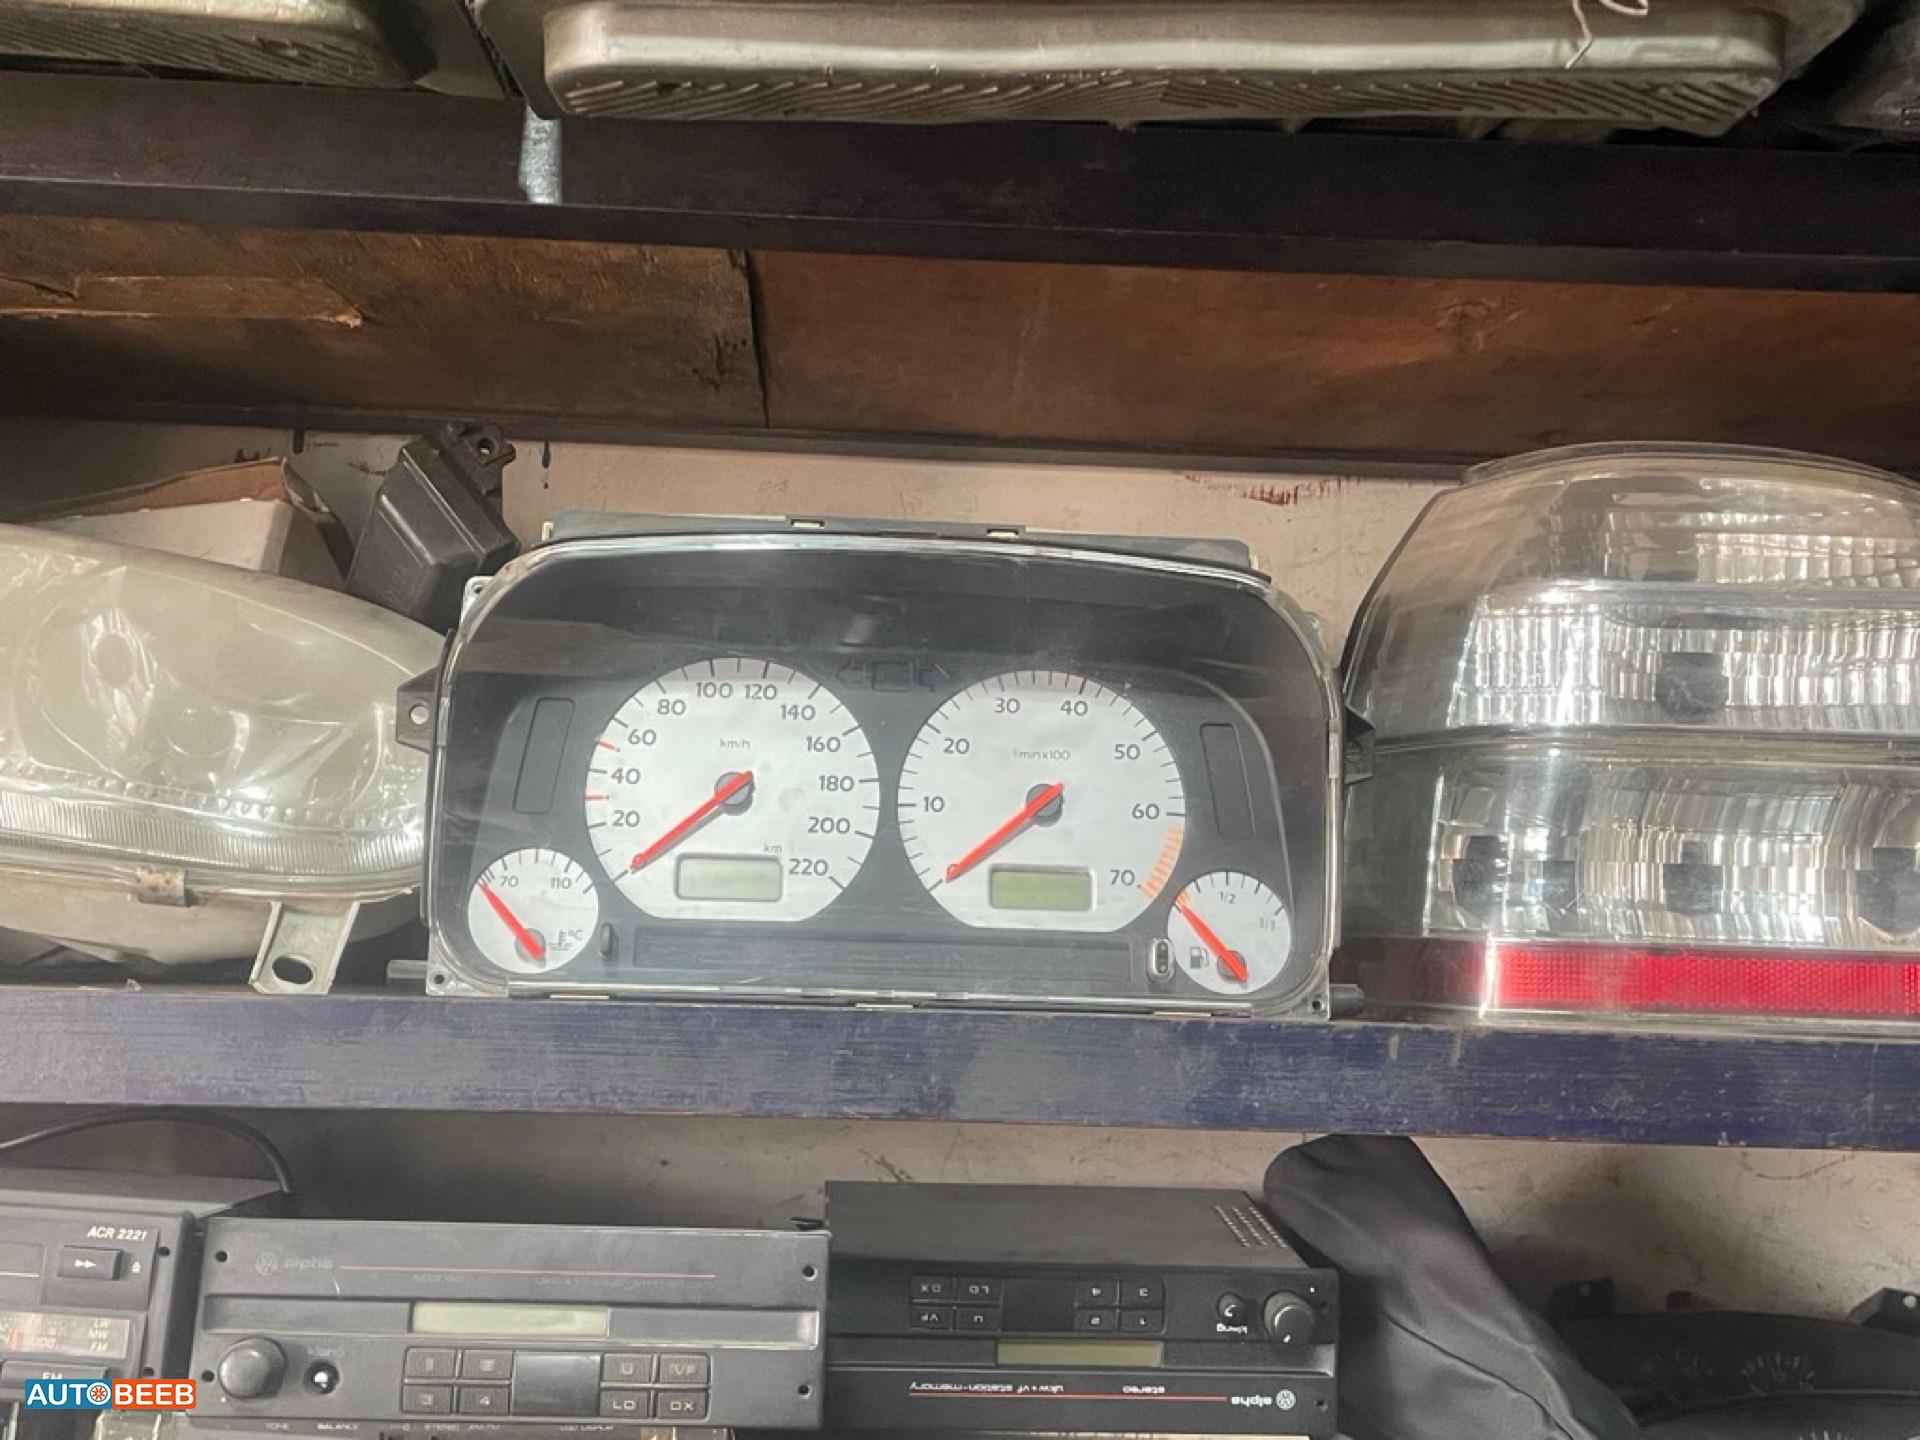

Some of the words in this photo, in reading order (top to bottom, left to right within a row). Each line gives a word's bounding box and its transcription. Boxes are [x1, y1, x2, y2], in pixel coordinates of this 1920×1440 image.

[696, 682, 733, 699] 100
[744, 684, 778, 701] 120
[657, 699, 686, 715] 80
[781, 704, 816, 721] 140
[994, 697, 1020, 713] 30
[1060, 700, 1088, 717] 40
[628, 729, 657, 746] 60
[806, 736, 841, 753] 160
[943, 738, 970, 755] 20
[1114, 744, 1141, 760] 50
[610, 768, 641, 785] 40
[819, 775, 854, 792] 180
[923, 796, 945, 812] 10
[1131, 803, 1160, 820] 60
[612, 811, 640, 828] 20
[807, 817, 851, 835] 200
[788, 859, 829, 876] 220
[500, 876, 519, 888] 70
[551, 877, 572, 889] 110
[1109, 869, 1135, 886] 70
[86, 1225, 115, 1240] ACR
[116, 1227, 148, 1241] 2221
[670, 1401, 694, 1411] DX
[1230, 1394, 1273, 1407] alpha
